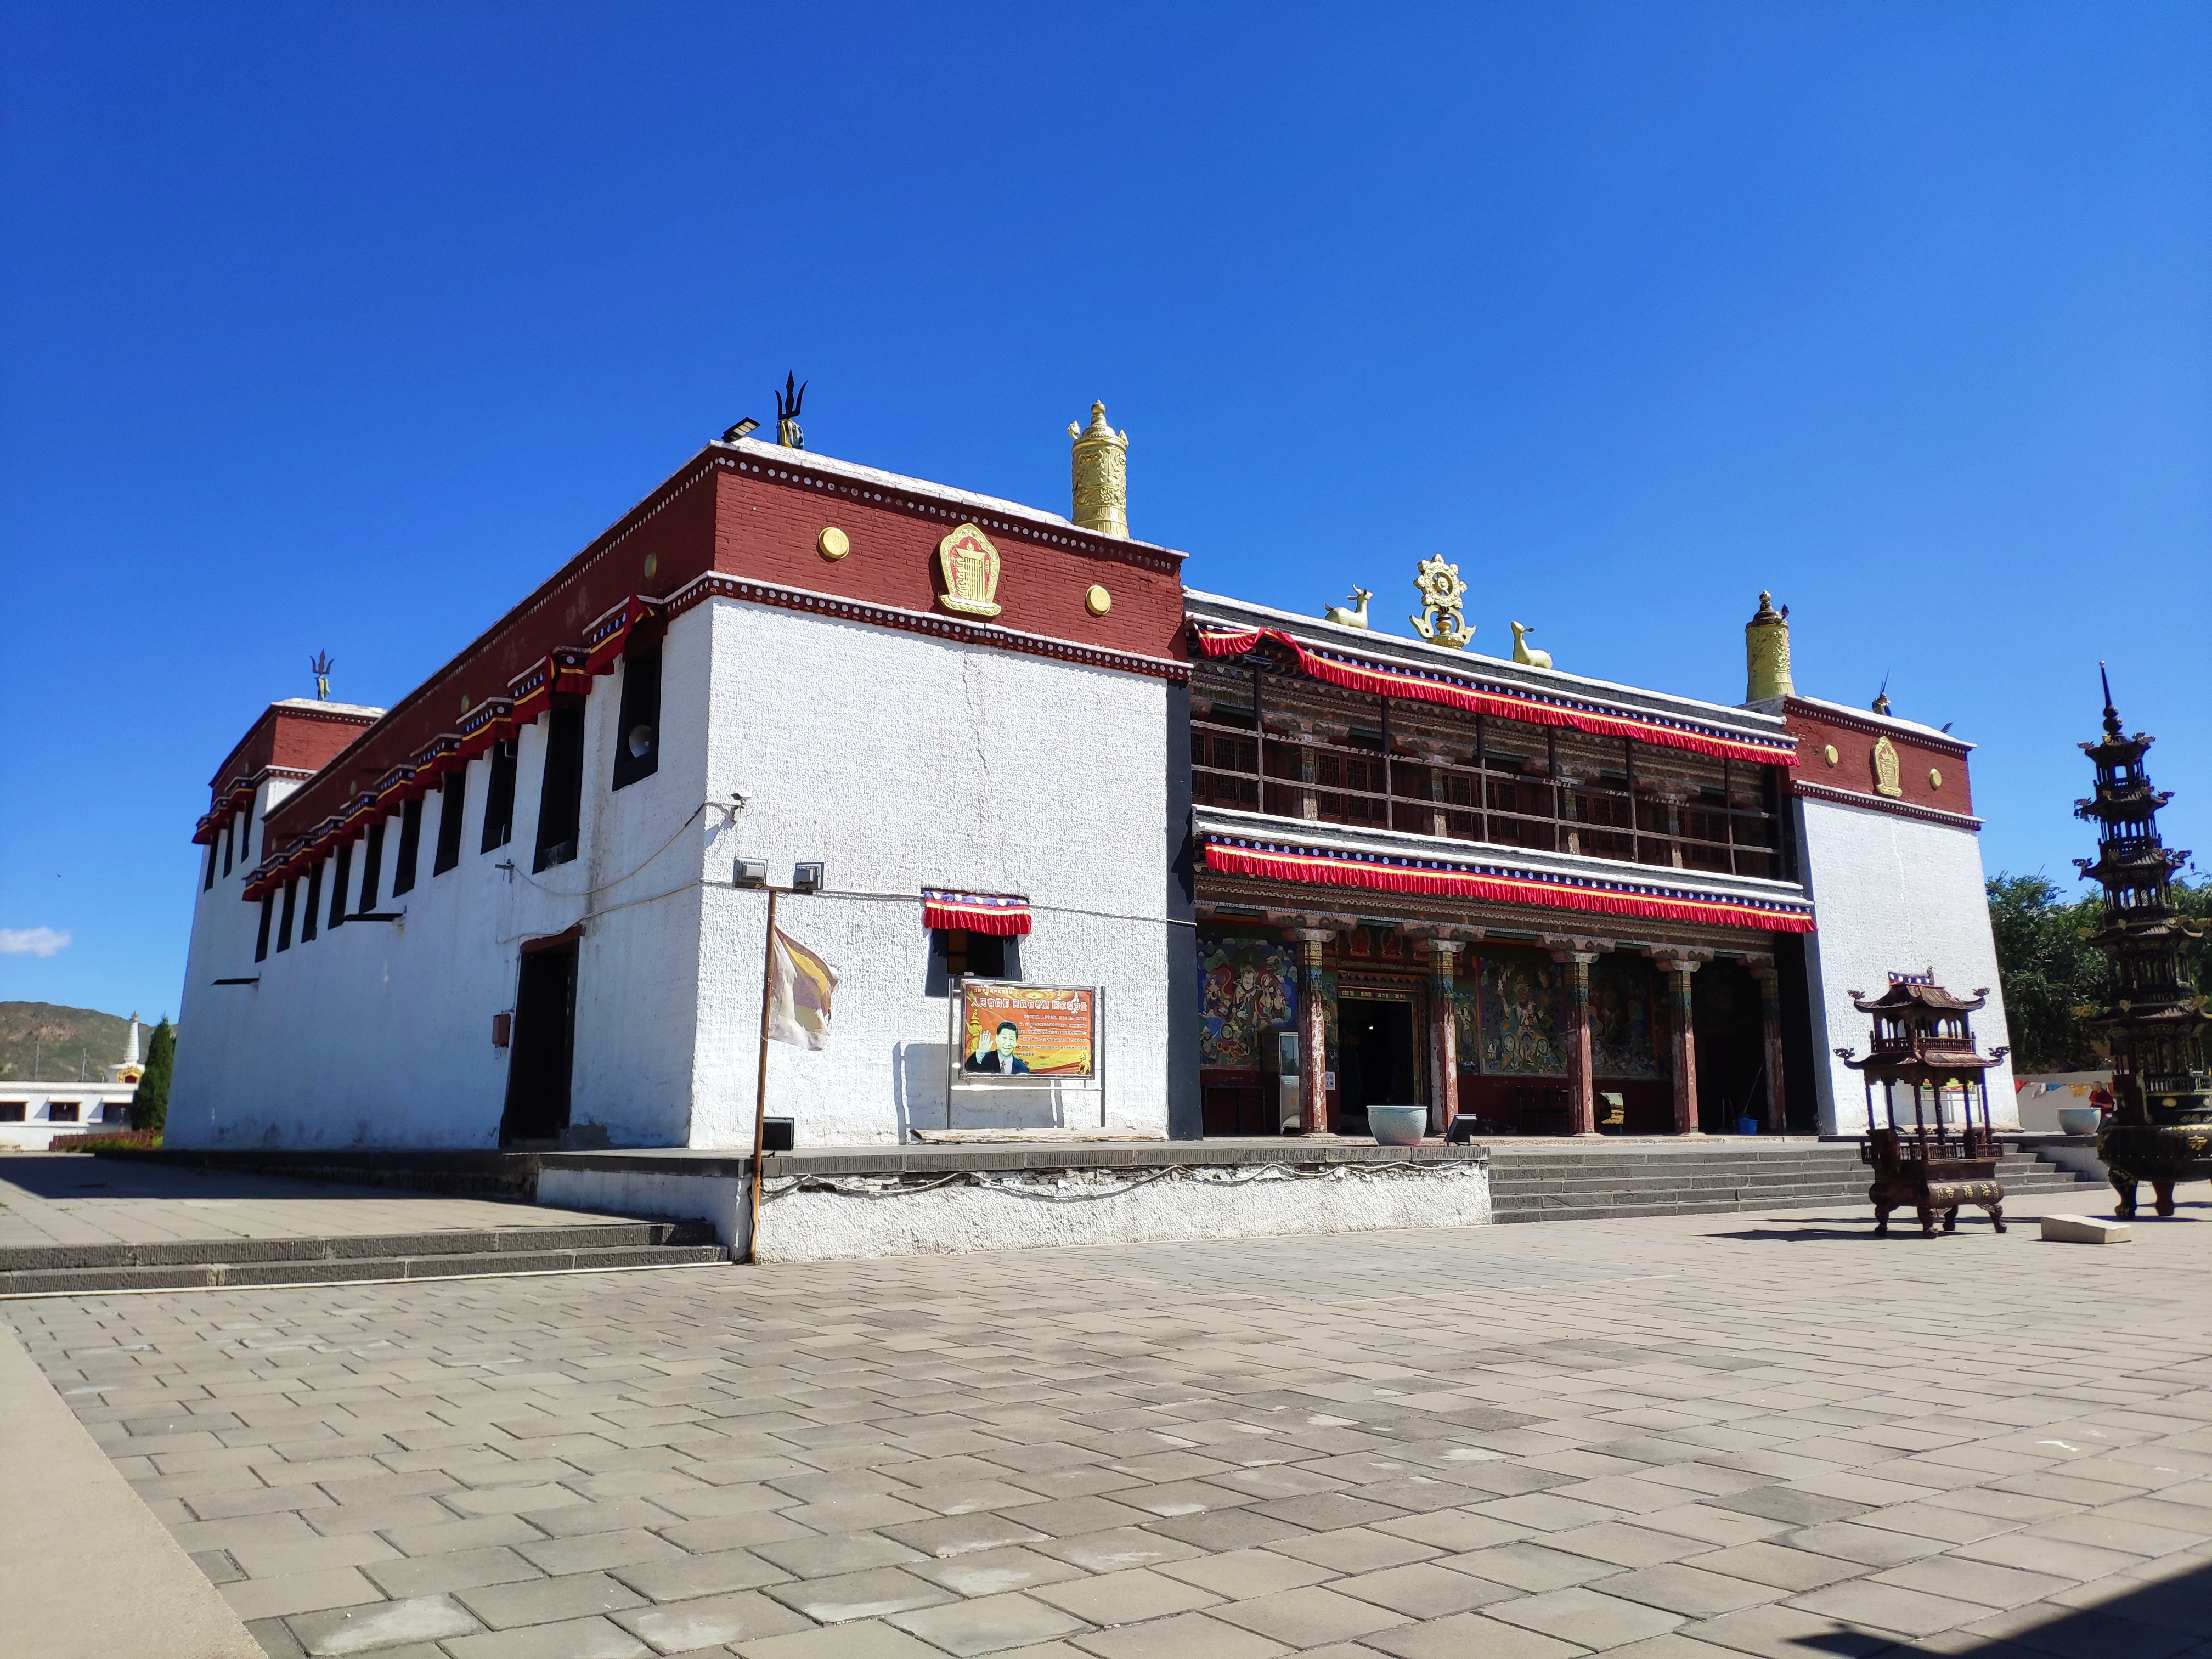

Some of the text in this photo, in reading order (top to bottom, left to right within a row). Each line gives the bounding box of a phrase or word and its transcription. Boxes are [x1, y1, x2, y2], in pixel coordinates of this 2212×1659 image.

[971, 998, 1087, 1011] 人民有信仰 民族有希望 国家有力量
